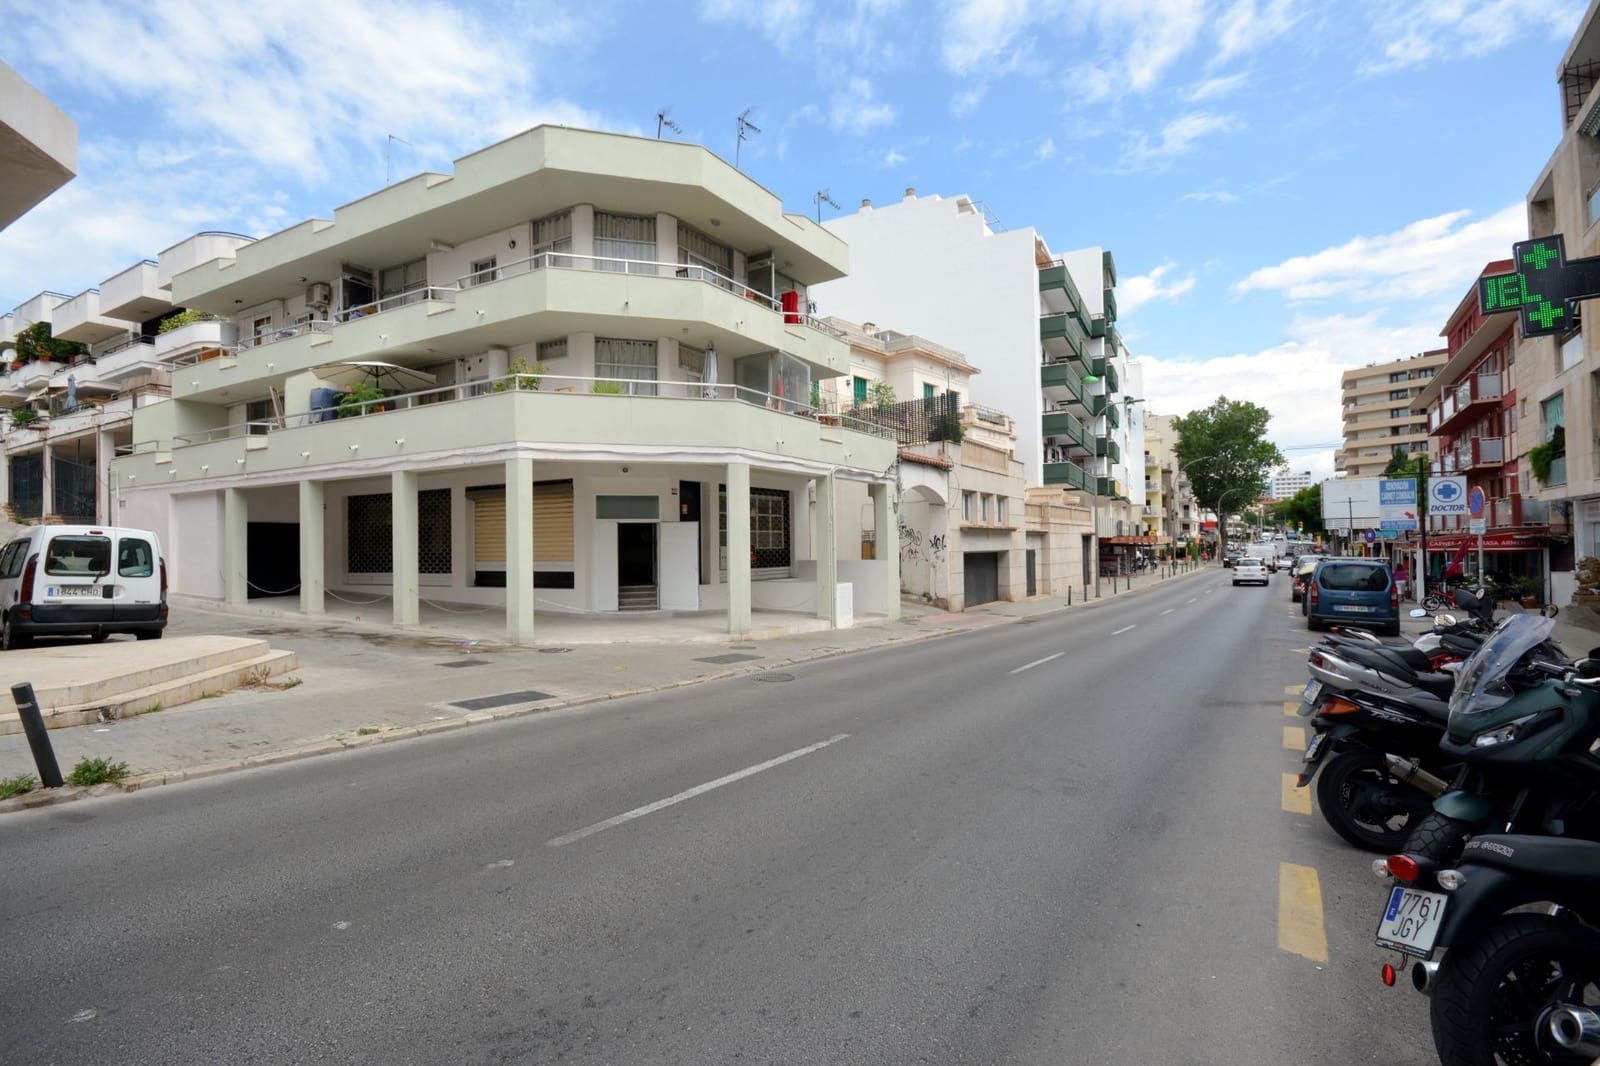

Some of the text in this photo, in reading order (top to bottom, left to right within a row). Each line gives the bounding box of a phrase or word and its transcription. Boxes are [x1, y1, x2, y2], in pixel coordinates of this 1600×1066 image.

[1430, 504, 1465, 512] DOCTOR
[1398, 893, 1441, 921] 7761
[1392, 916, 1428, 941] JGY
